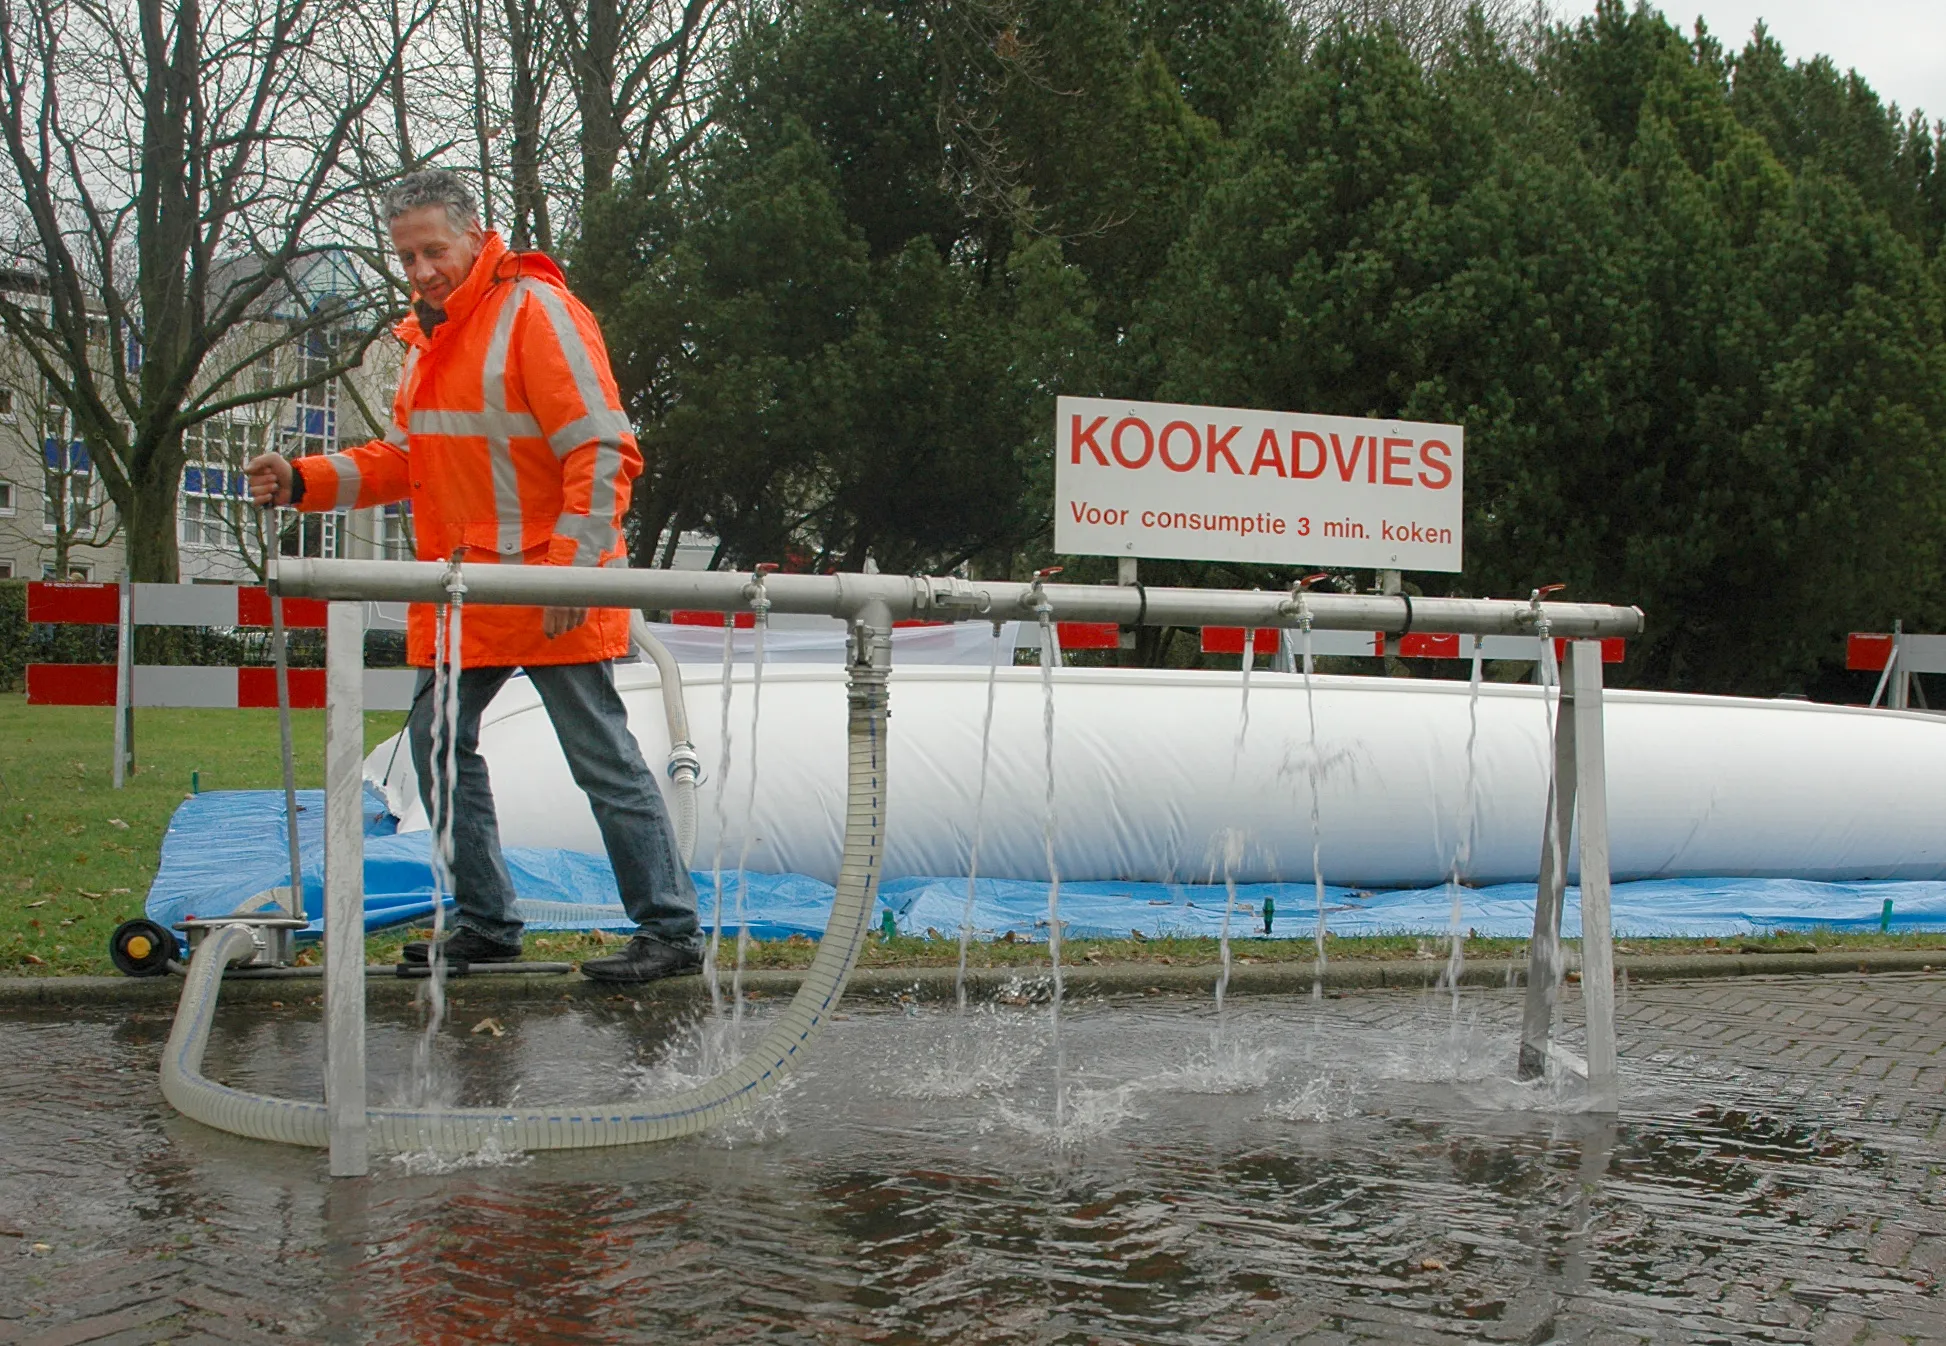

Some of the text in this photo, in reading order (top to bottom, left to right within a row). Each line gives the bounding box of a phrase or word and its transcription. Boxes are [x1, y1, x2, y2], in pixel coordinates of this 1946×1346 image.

[1070, 414, 1453, 490] KOOKADVIES
[1070, 501, 1452, 545] Voor consumptie 3 min. koken
